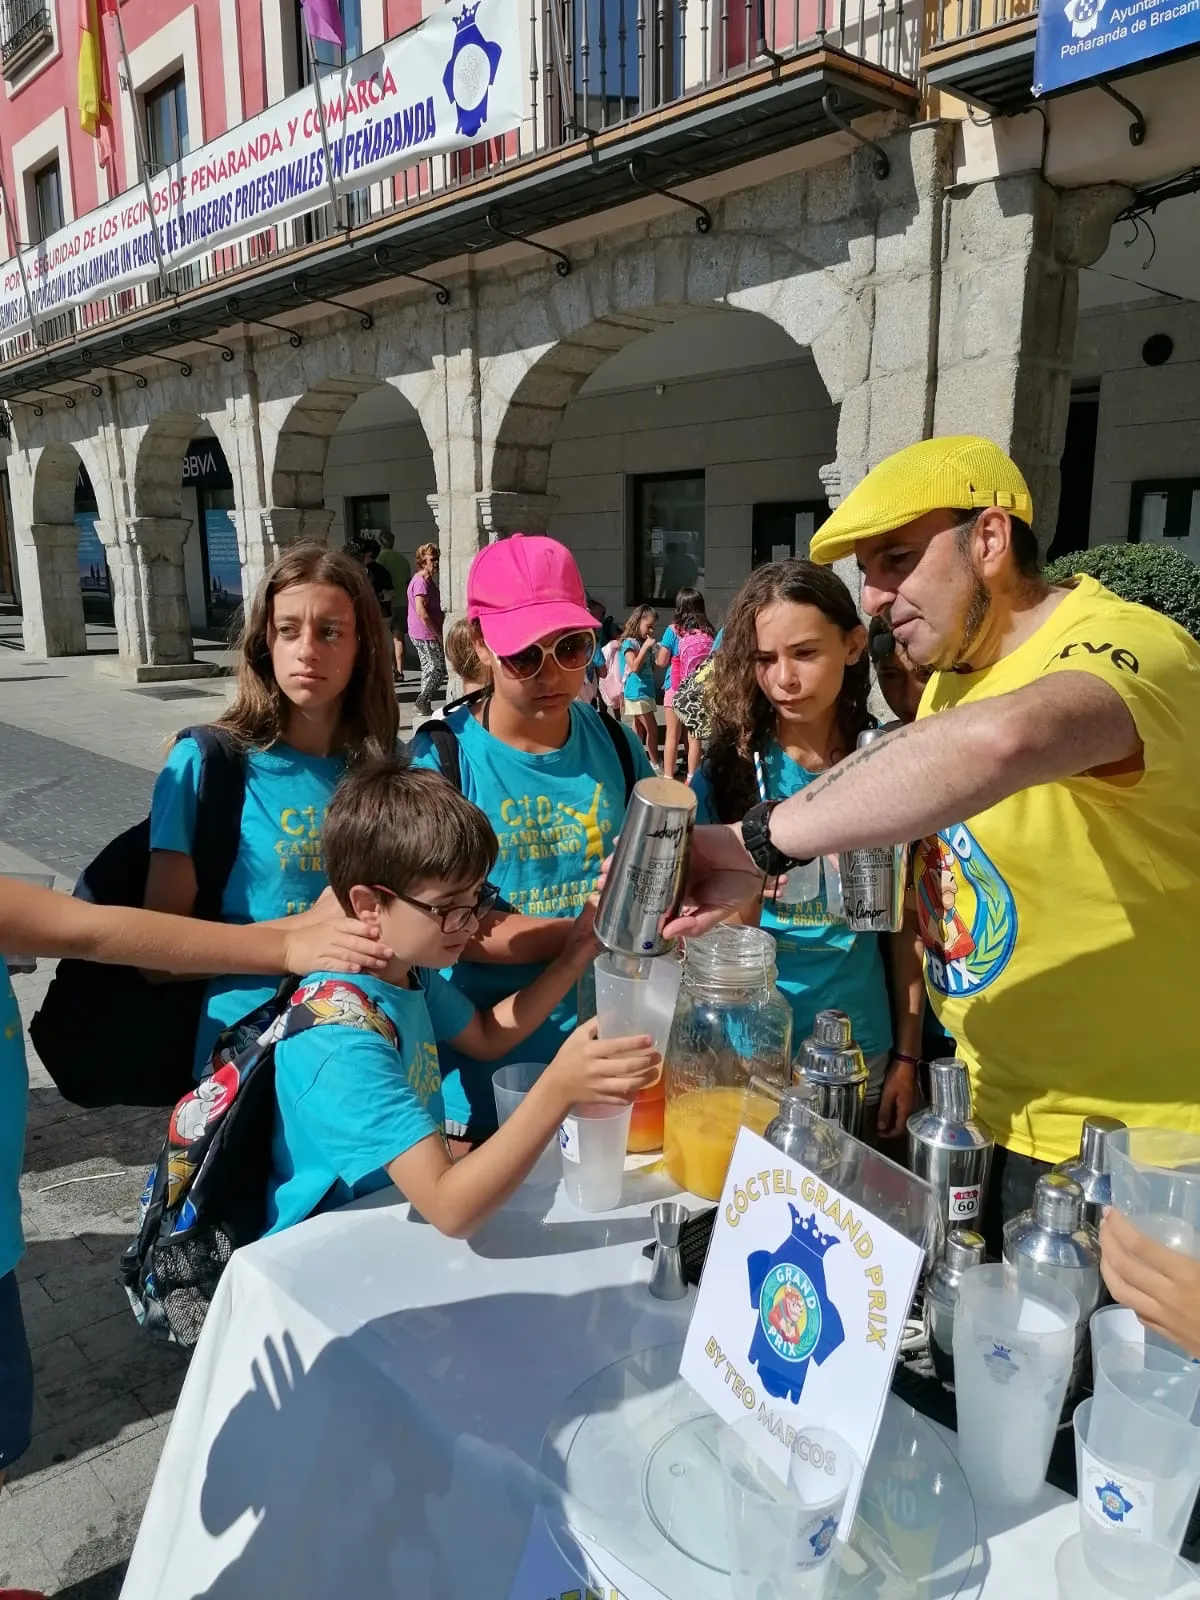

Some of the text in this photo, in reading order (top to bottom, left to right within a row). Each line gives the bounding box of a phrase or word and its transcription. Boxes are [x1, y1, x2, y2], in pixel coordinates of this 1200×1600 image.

[1060, 26, 1128, 59] Peñaranda
[1131, 20, 1147, 34] de
[4, 270, 21, 295] POR
[34, 235, 81, 279] SEGURIDAD
[83, 227, 97, 252] DE
[100, 215, 118, 244] LOS
[121, 187, 168, 231] VECINOS
[171, 176, 188, 206] DE
[191, 127, 283, 196] PEÑARANDA
[287, 117, 299, 147] Y
[303, 66, 398, 139] COMARCA
[67, 268, 77, 298] DE
[77, 247, 120, 293] SALAMANCA
[120, 239, 132, 274] UN
[132, 224, 166, 268] PARQE
[166, 218, 178, 254] DE
[178, 192, 233, 248] BOMBEROS
[234, 147, 324, 223] PROFESIONALES
[344, 95, 436, 174] PEÑARANDA
[957, 1200, 975, 1212] 60
[725, 1169, 888, 1351] CÓCTEL GRAND PRIX
[775, 1266, 817, 1310] GRAND
[767, 1325, 797, 1357] PRIX
[704, 1335, 727, 1369] BY
[723, 1360, 756, 1410] TEO
[757, 1401, 837, 1476] MARCOS
